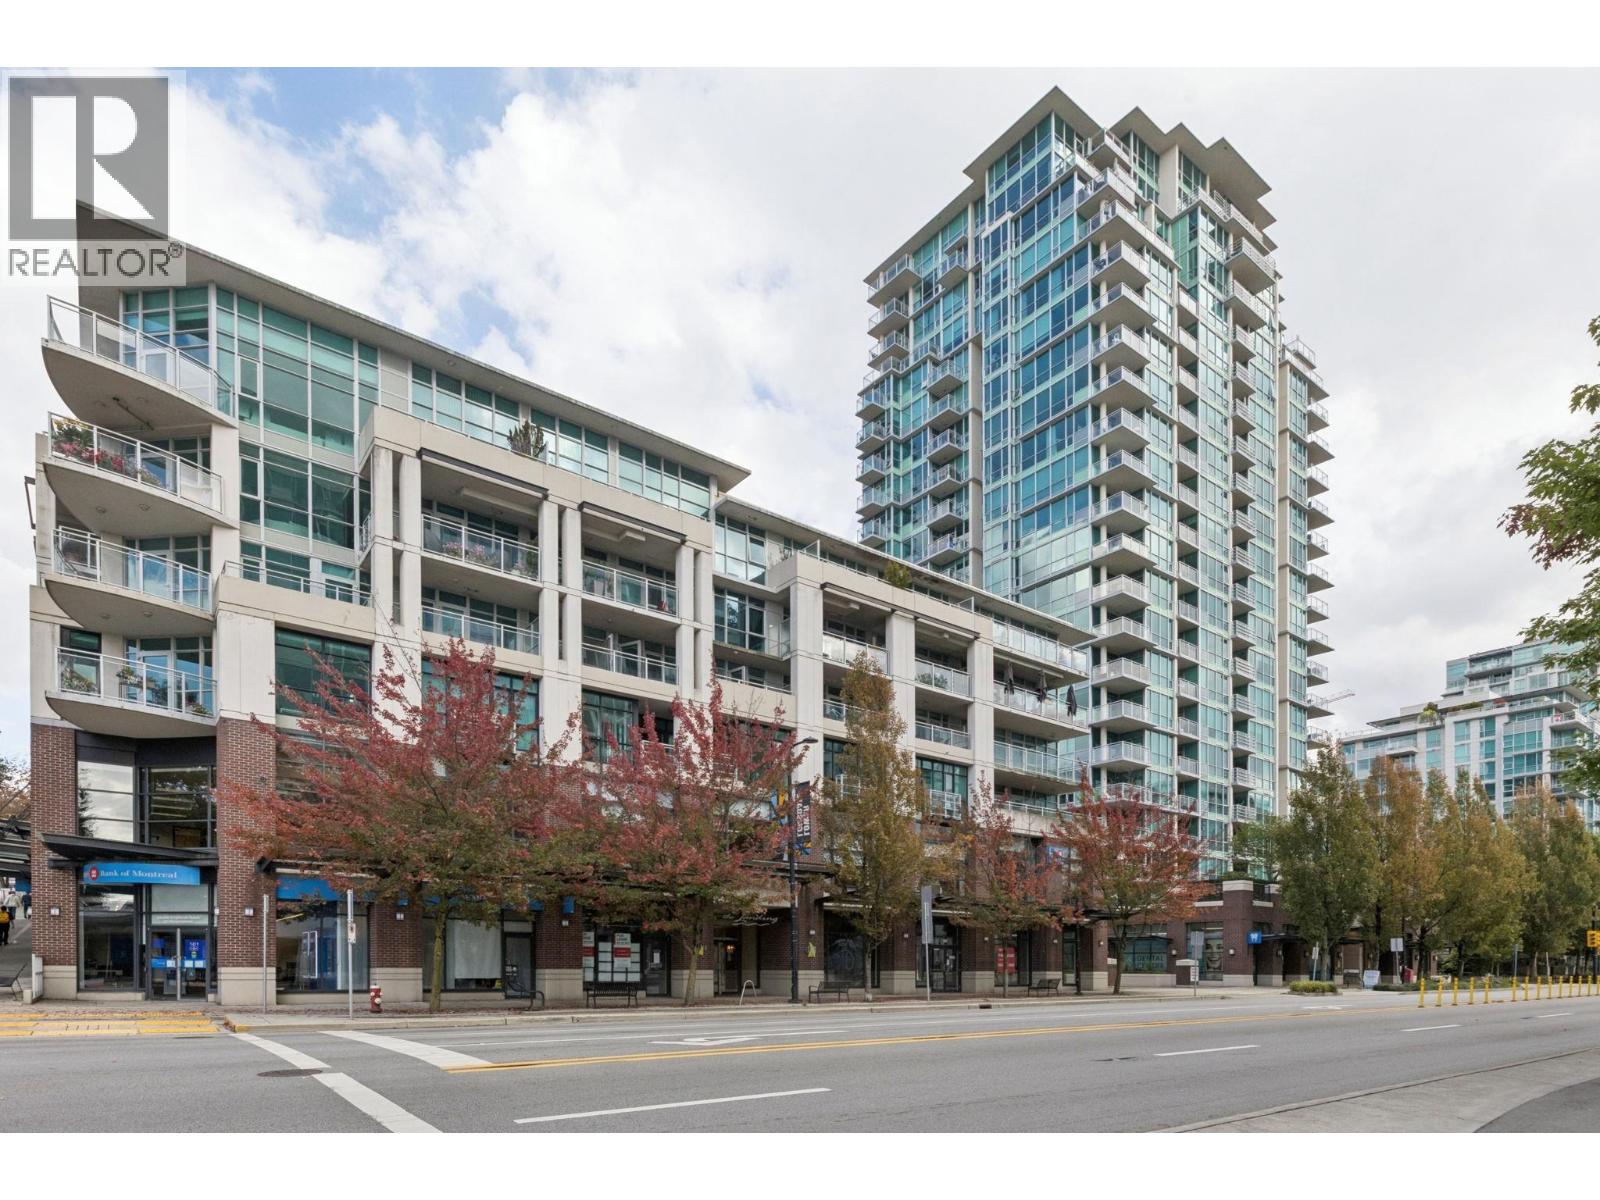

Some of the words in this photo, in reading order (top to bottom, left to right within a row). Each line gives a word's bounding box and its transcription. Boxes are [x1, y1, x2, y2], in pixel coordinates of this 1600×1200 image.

[100, 869, 119, 877] Bank
[121, 869, 129, 877] of
[132, 869, 177, 879] Montreal
